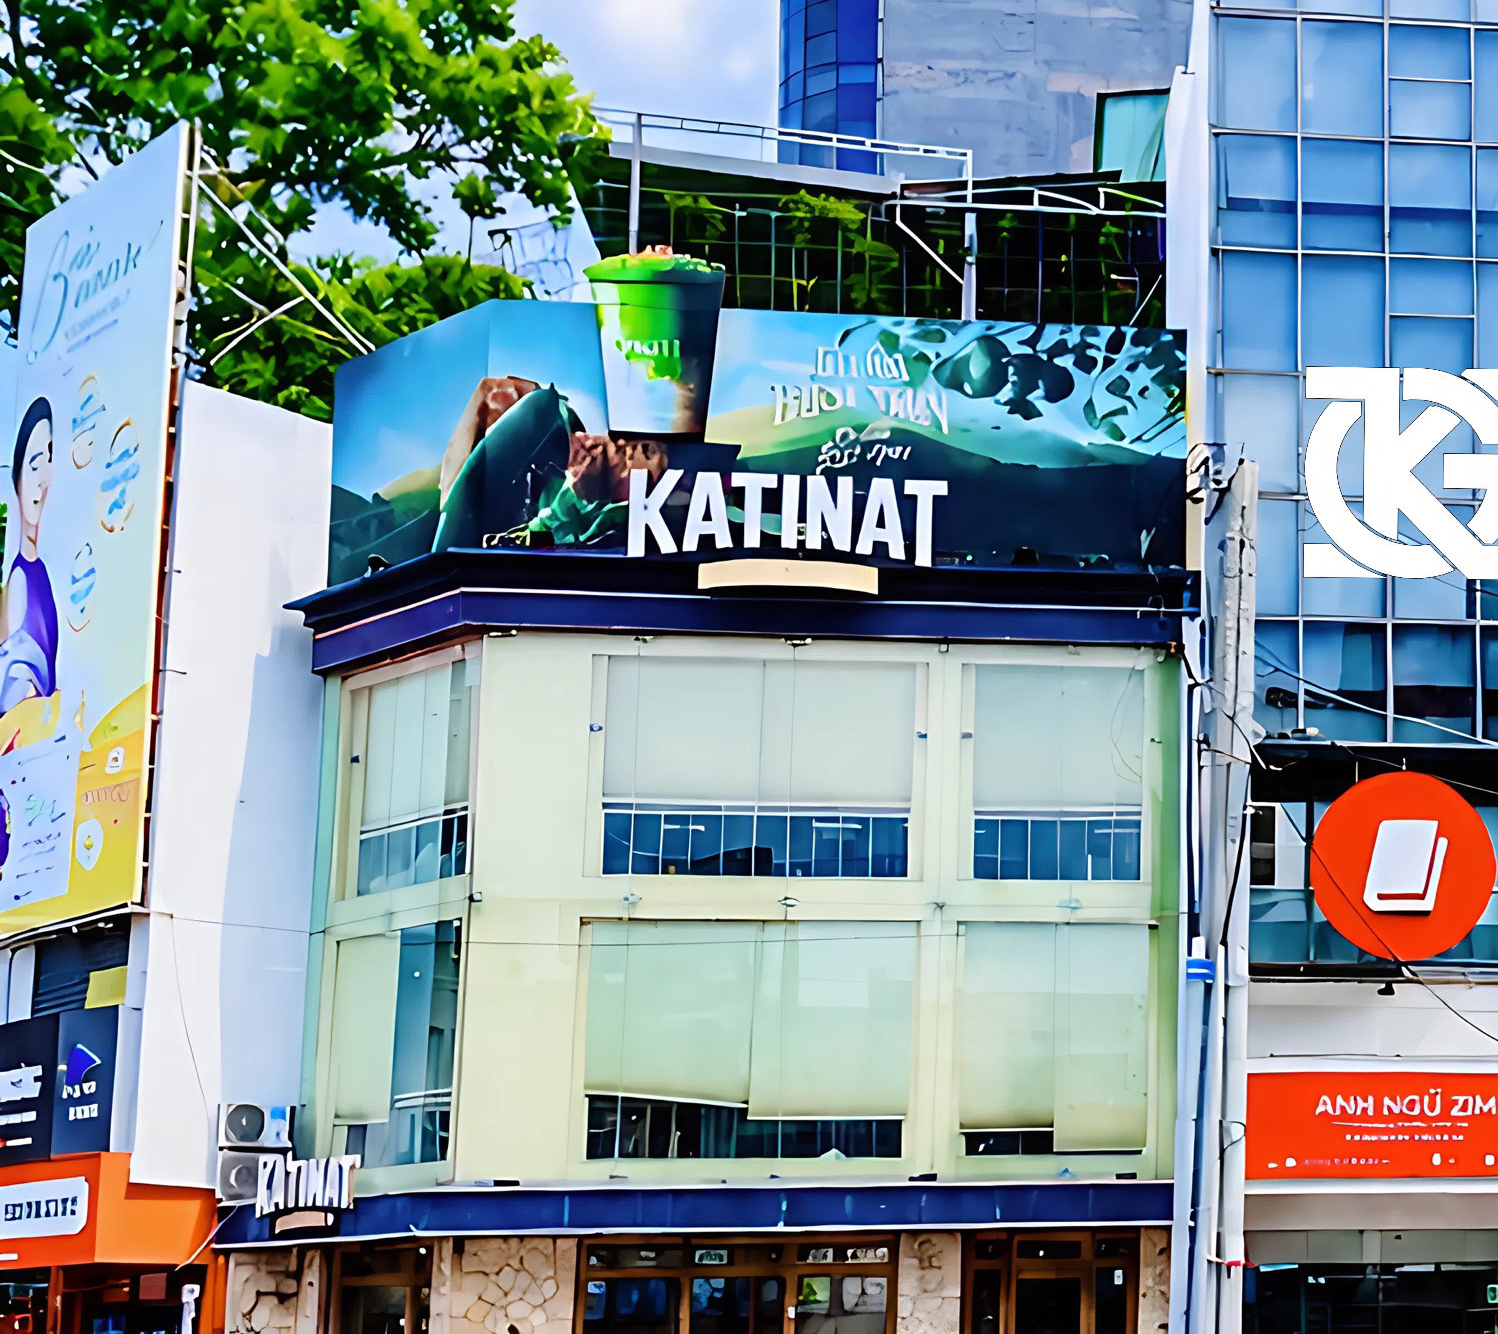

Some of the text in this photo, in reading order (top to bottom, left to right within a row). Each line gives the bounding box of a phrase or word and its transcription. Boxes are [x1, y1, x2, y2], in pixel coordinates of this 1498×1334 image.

[627, 468, 949, 567] KATINAT
[1315, 1095, 1374, 1116] ANH
[1450, 1095, 1497, 1116] ZIM
